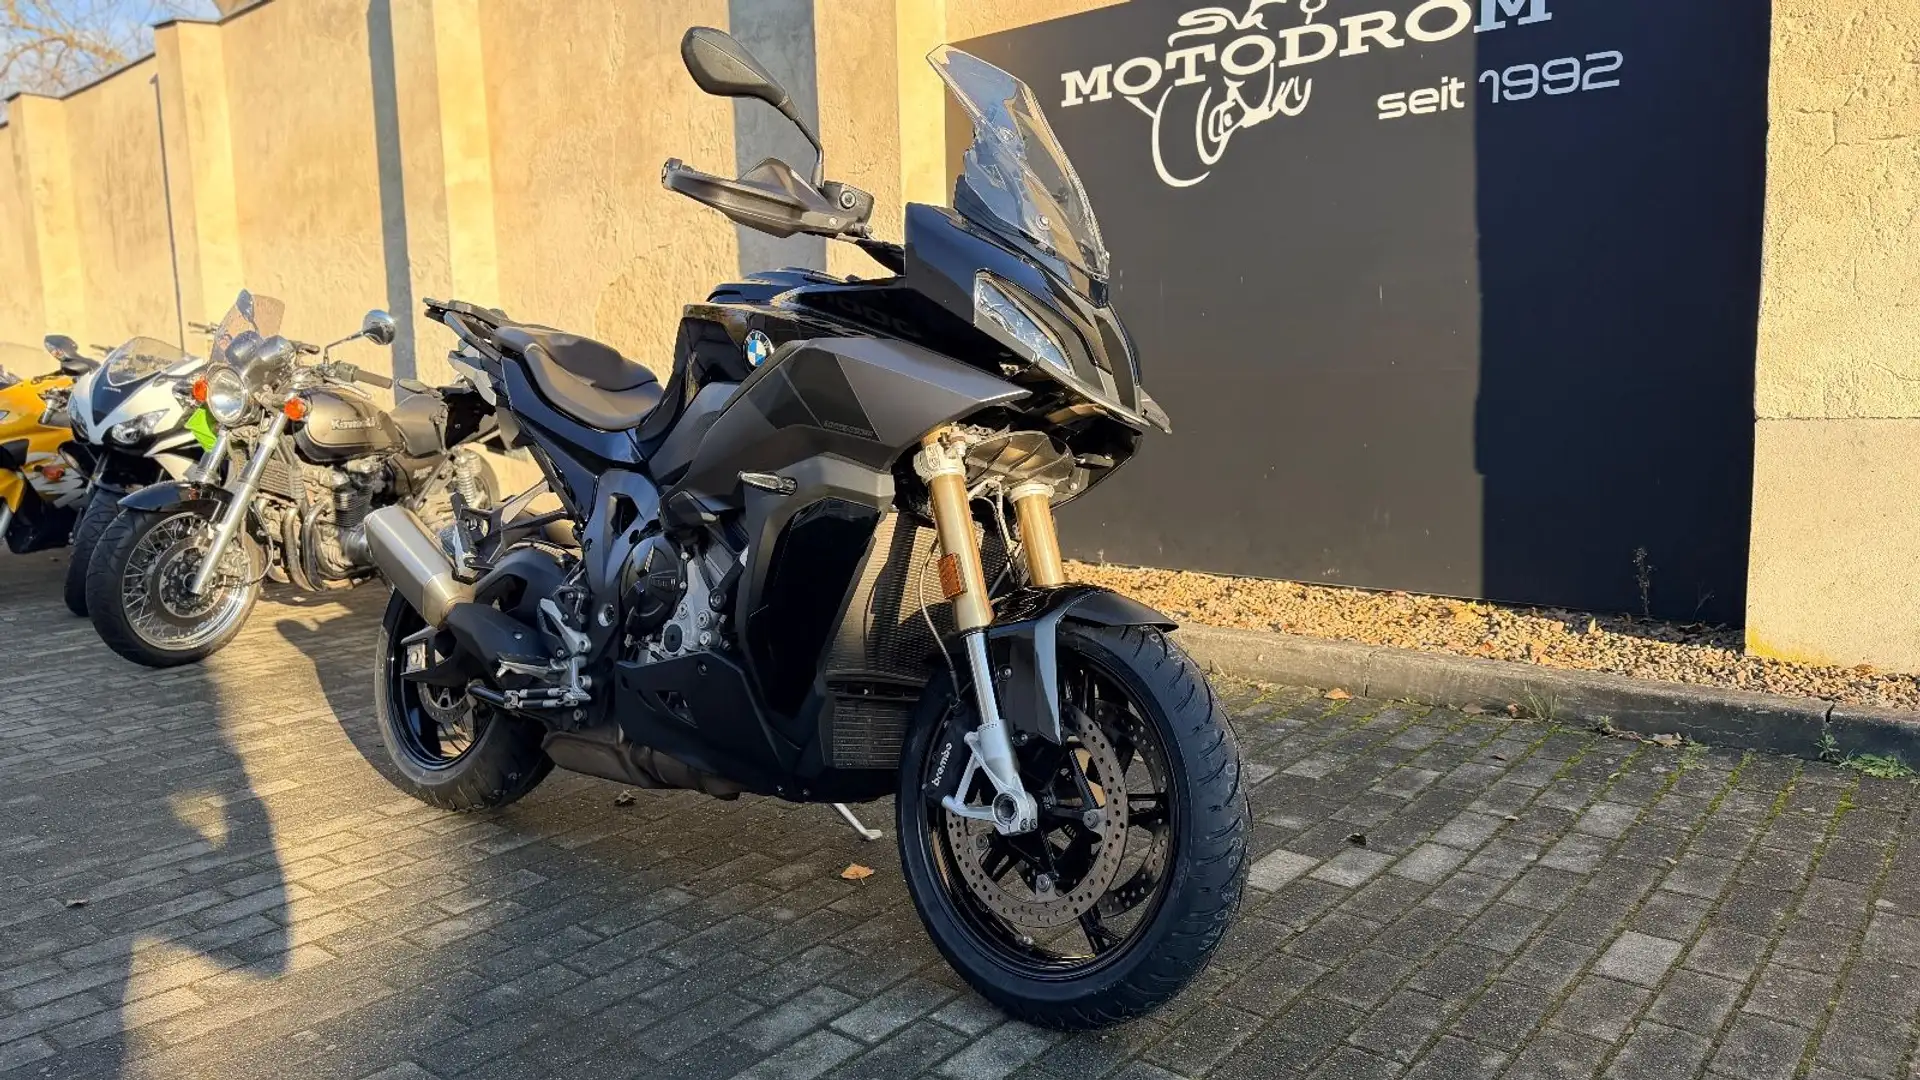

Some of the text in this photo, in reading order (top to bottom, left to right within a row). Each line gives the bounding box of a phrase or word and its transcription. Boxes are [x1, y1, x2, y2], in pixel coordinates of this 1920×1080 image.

[1061, 0, 1552, 107] MOTODROM
[1377, 50, 1624, 120] seit 1992
[932, 743, 952, 787] brembo
